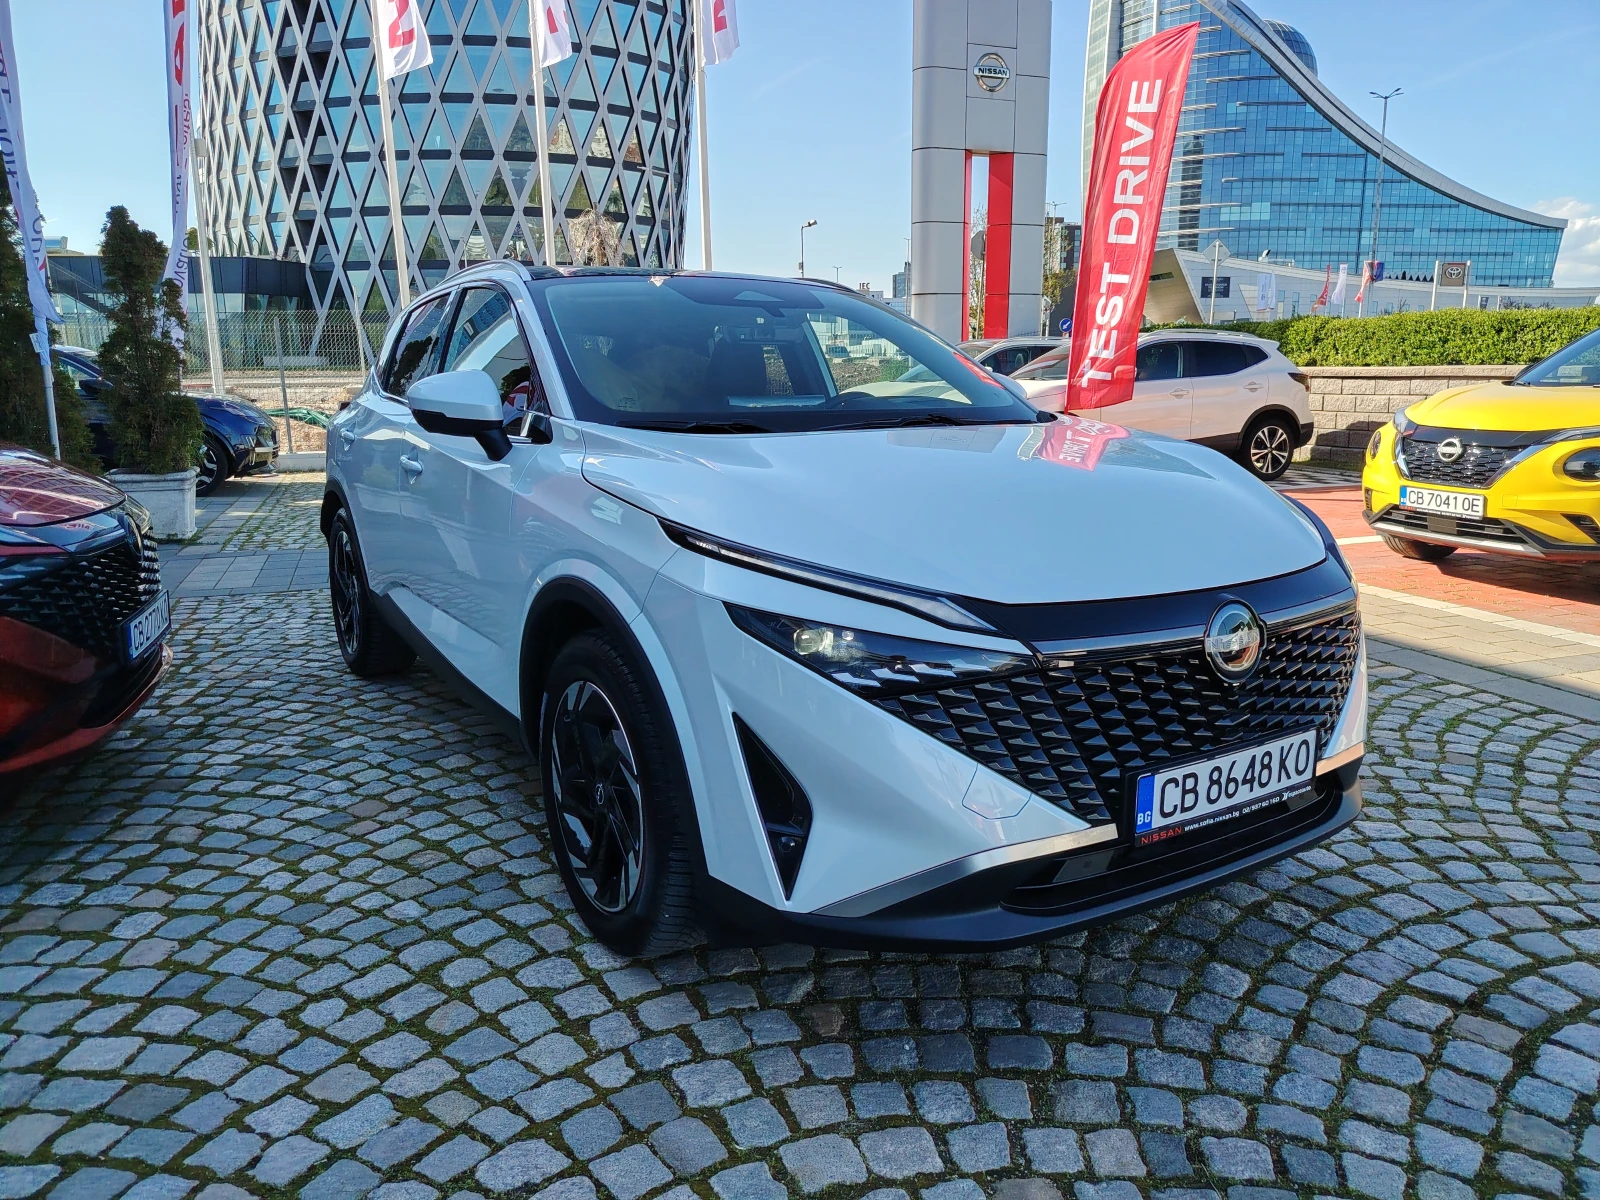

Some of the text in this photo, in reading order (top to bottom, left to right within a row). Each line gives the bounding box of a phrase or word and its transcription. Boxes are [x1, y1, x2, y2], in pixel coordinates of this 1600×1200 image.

[978, 67, 1008, 77] NISSAN
[1081, 262, 1130, 388] TEST
[1107, 79, 1162, 245] DRIVE
[859, 282, 870, 290] IEC
[1408, 490, 1424, 505] CB
[1427, 492, 1458, 510] 7041
[1462, 497, 1481, 513] OE
[133, 620, 144, 651] CB
[1159, 738, 1310, 819] CB 8648 KO
[1137, 811, 1151, 825] BG
[1141, 826, 1182, 845] NISSAN
[1184, 811, 1240, 831] www.sofia.nissan.bg
